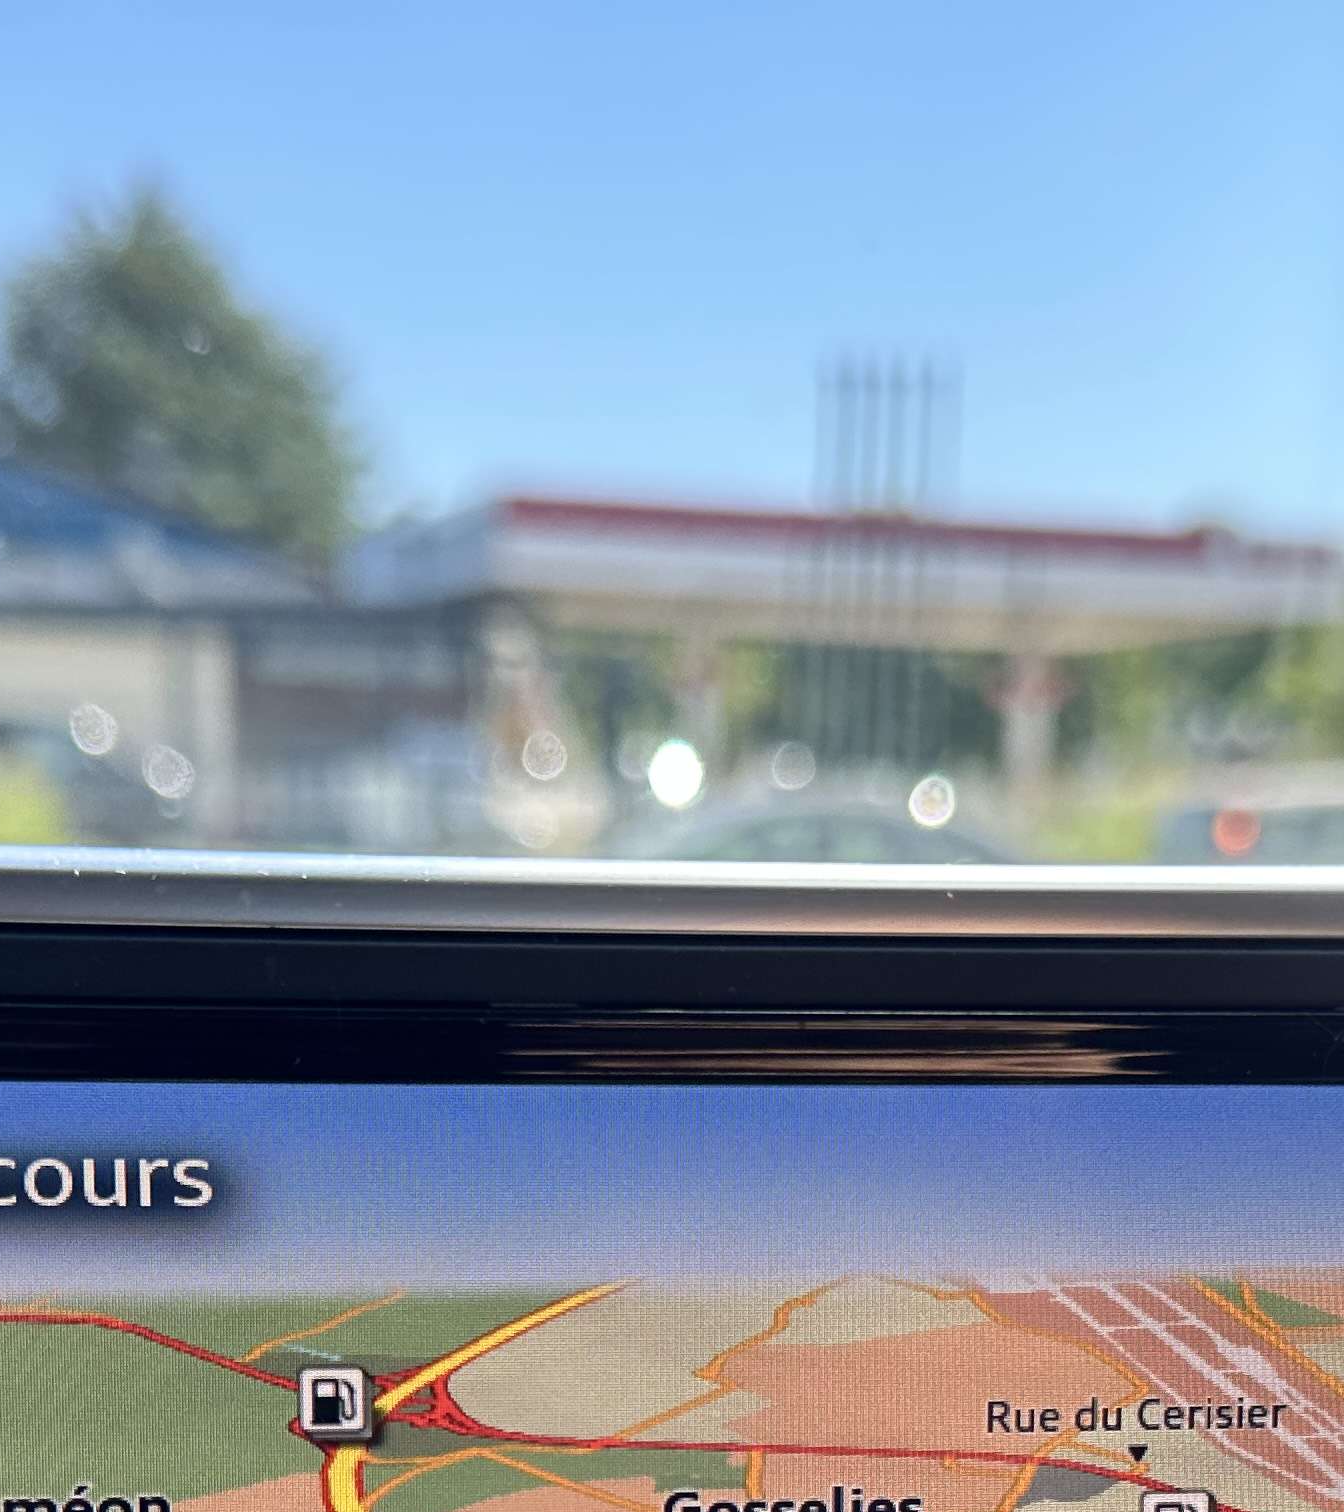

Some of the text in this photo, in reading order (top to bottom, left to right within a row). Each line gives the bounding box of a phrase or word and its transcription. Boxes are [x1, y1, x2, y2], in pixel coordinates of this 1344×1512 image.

[987, 1397, 1287, 1434] Rue du Cerisier
